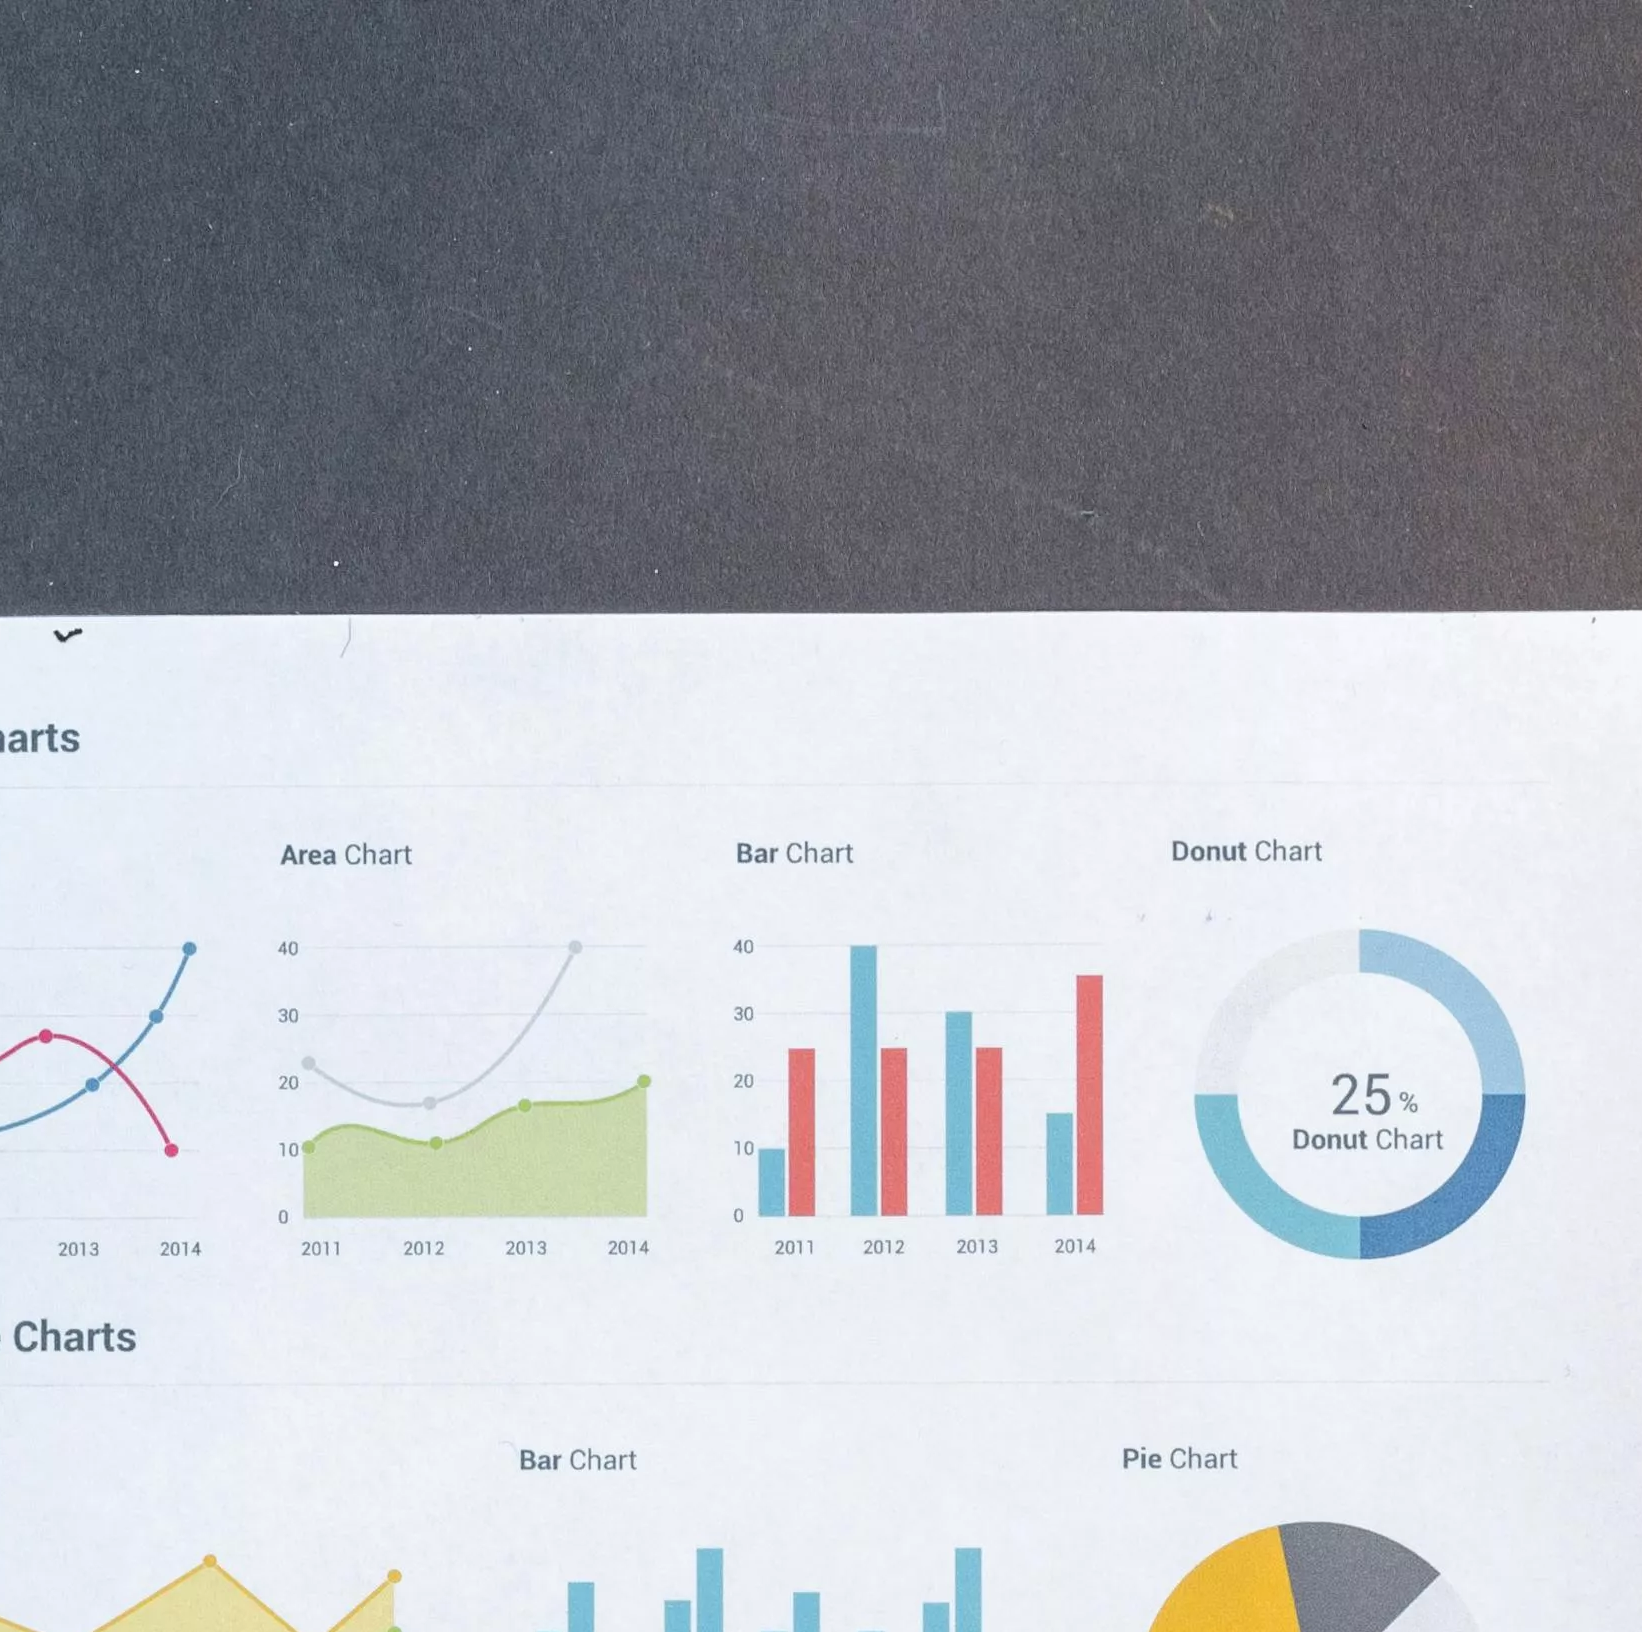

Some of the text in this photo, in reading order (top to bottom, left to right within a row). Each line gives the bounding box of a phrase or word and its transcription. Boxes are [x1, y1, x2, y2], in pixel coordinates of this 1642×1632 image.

[280, 842, 413, 866] Area Chart
[737, 840, 854, 864] Bar Chart
[1172, 838, 1323, 862] Donut Chart
[277, 941, 299, 956] 40
[733, 939, 754, 954] 40
[278, 1007, 299, 1024] 30
[733, 1006, 754, 1022] 30
[278, 1075, 299, 1091] 20
[733, 1073, 754, 1089] 20
[1293, 1127, 1444, 1151] Donut Chart
[279, 1142, 299, 1158] 10
[734, 1140, 755, 1156] 10
[278, 1209, 289, 1225] 0
[733, 1207, 744, 1223] 0
[58, 1241, 99, 1257] 2013
[160, 1241, 202, 1257] 2014
[301, 1240, 650, 1257] 2011 2012 2013 2014
[775, 1238, 1096, 1255] 2011 2012 2013 2014
[13, 1318, 137, 1353] Charts
[520, 1447, 638, 1471] Bar Chart
[1123, 1446, 1238, 1470] Pie Chart
